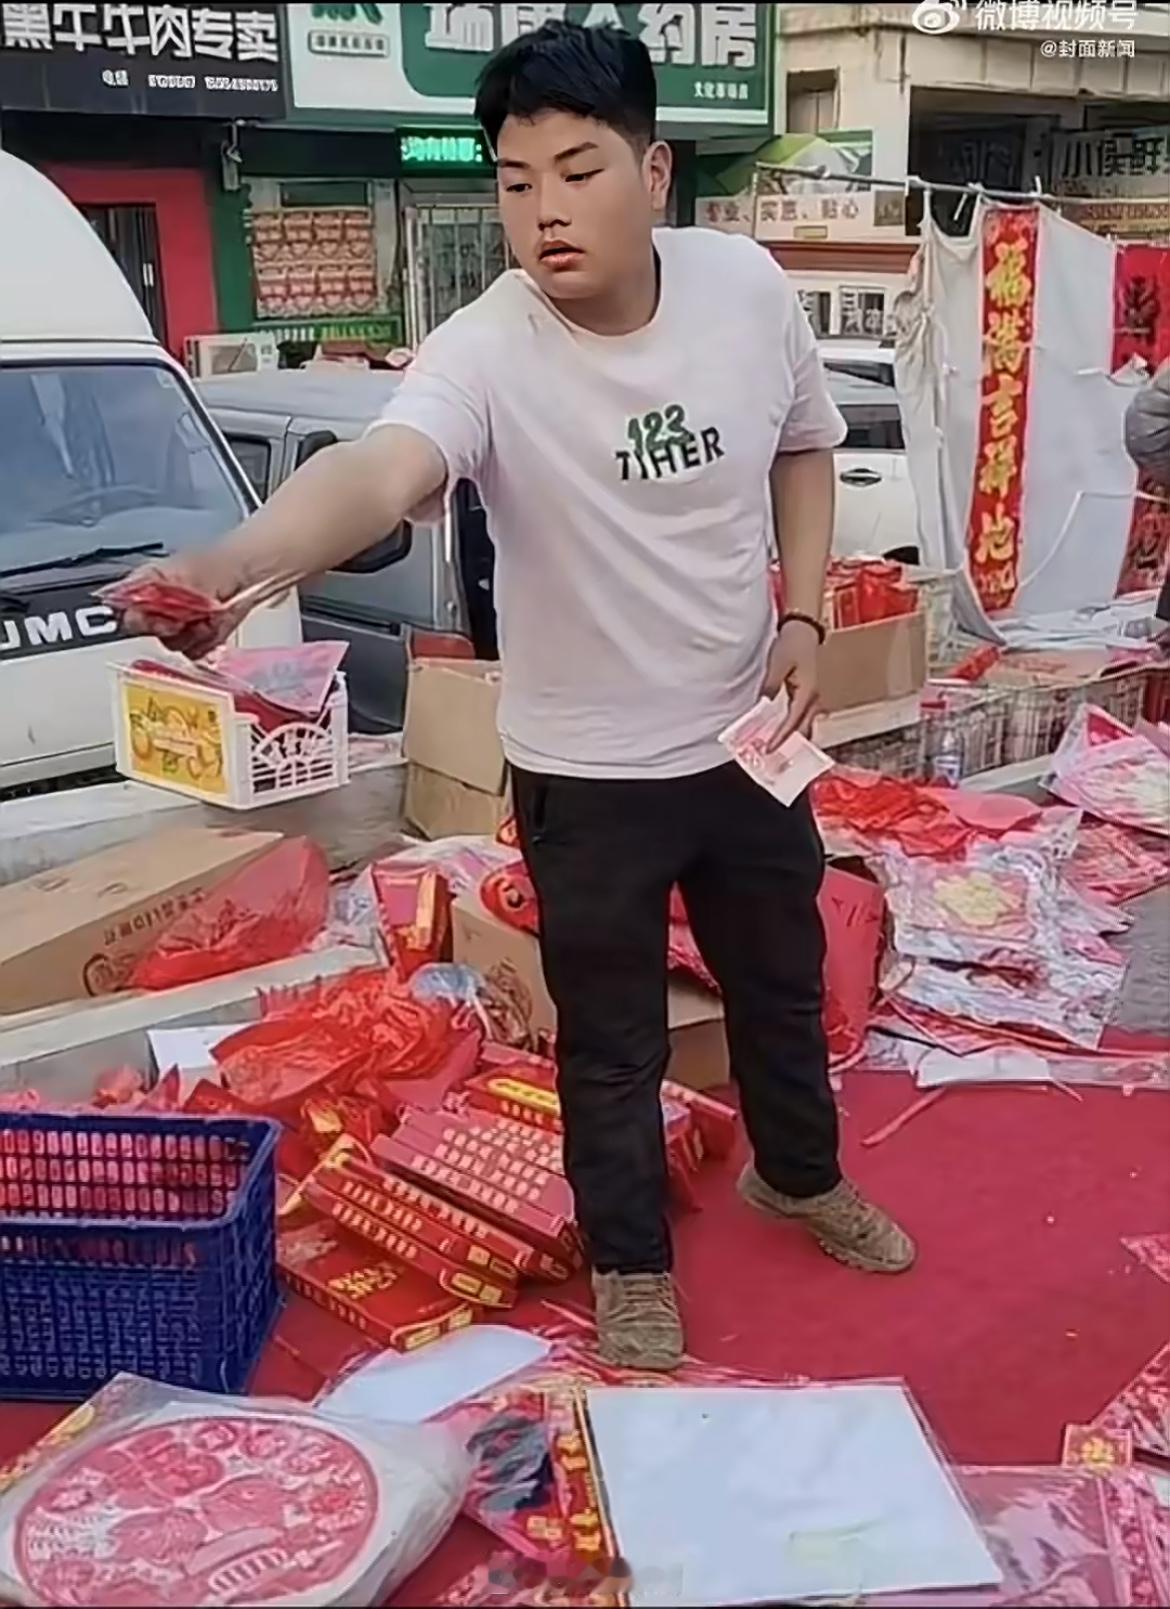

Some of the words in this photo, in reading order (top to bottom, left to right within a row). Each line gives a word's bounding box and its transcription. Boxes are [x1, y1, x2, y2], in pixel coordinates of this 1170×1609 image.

[3, 3, 279, 62] 黑牛牛肉专卖
